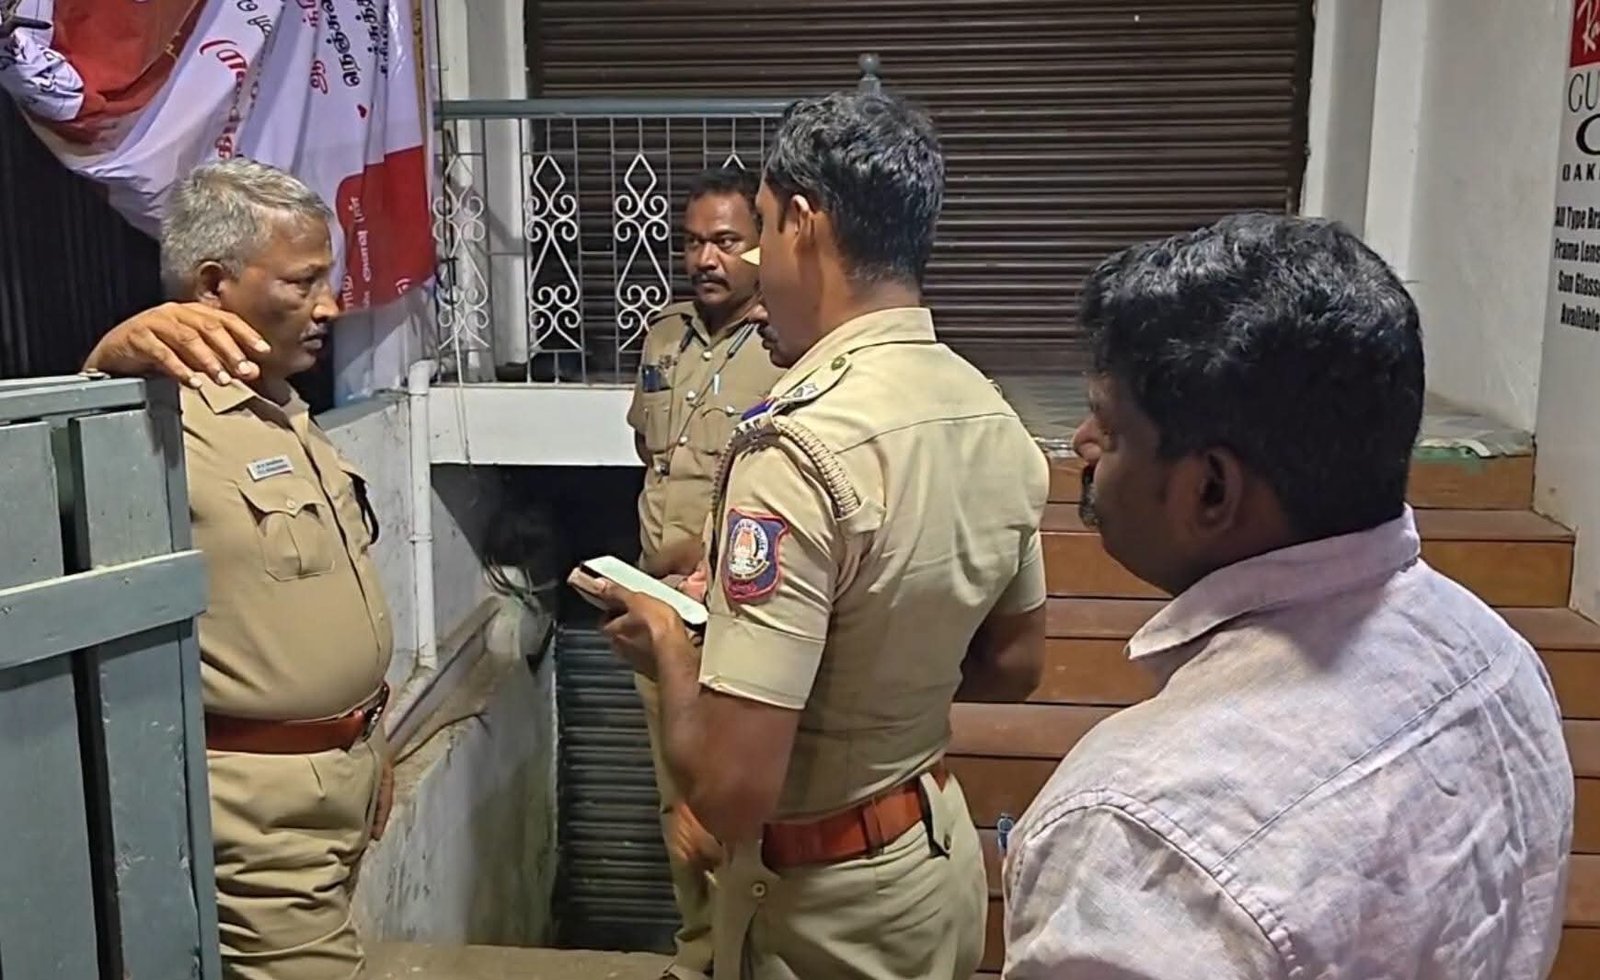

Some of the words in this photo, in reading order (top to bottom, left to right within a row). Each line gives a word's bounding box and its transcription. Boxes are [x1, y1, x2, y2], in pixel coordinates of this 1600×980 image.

[1562, 163, 1600, 182] OAK
[1567, 206, 1586, 231] Type
[1554, 237, 1579, 261] Frame
[1558, 269, 1573, 293] Sun
